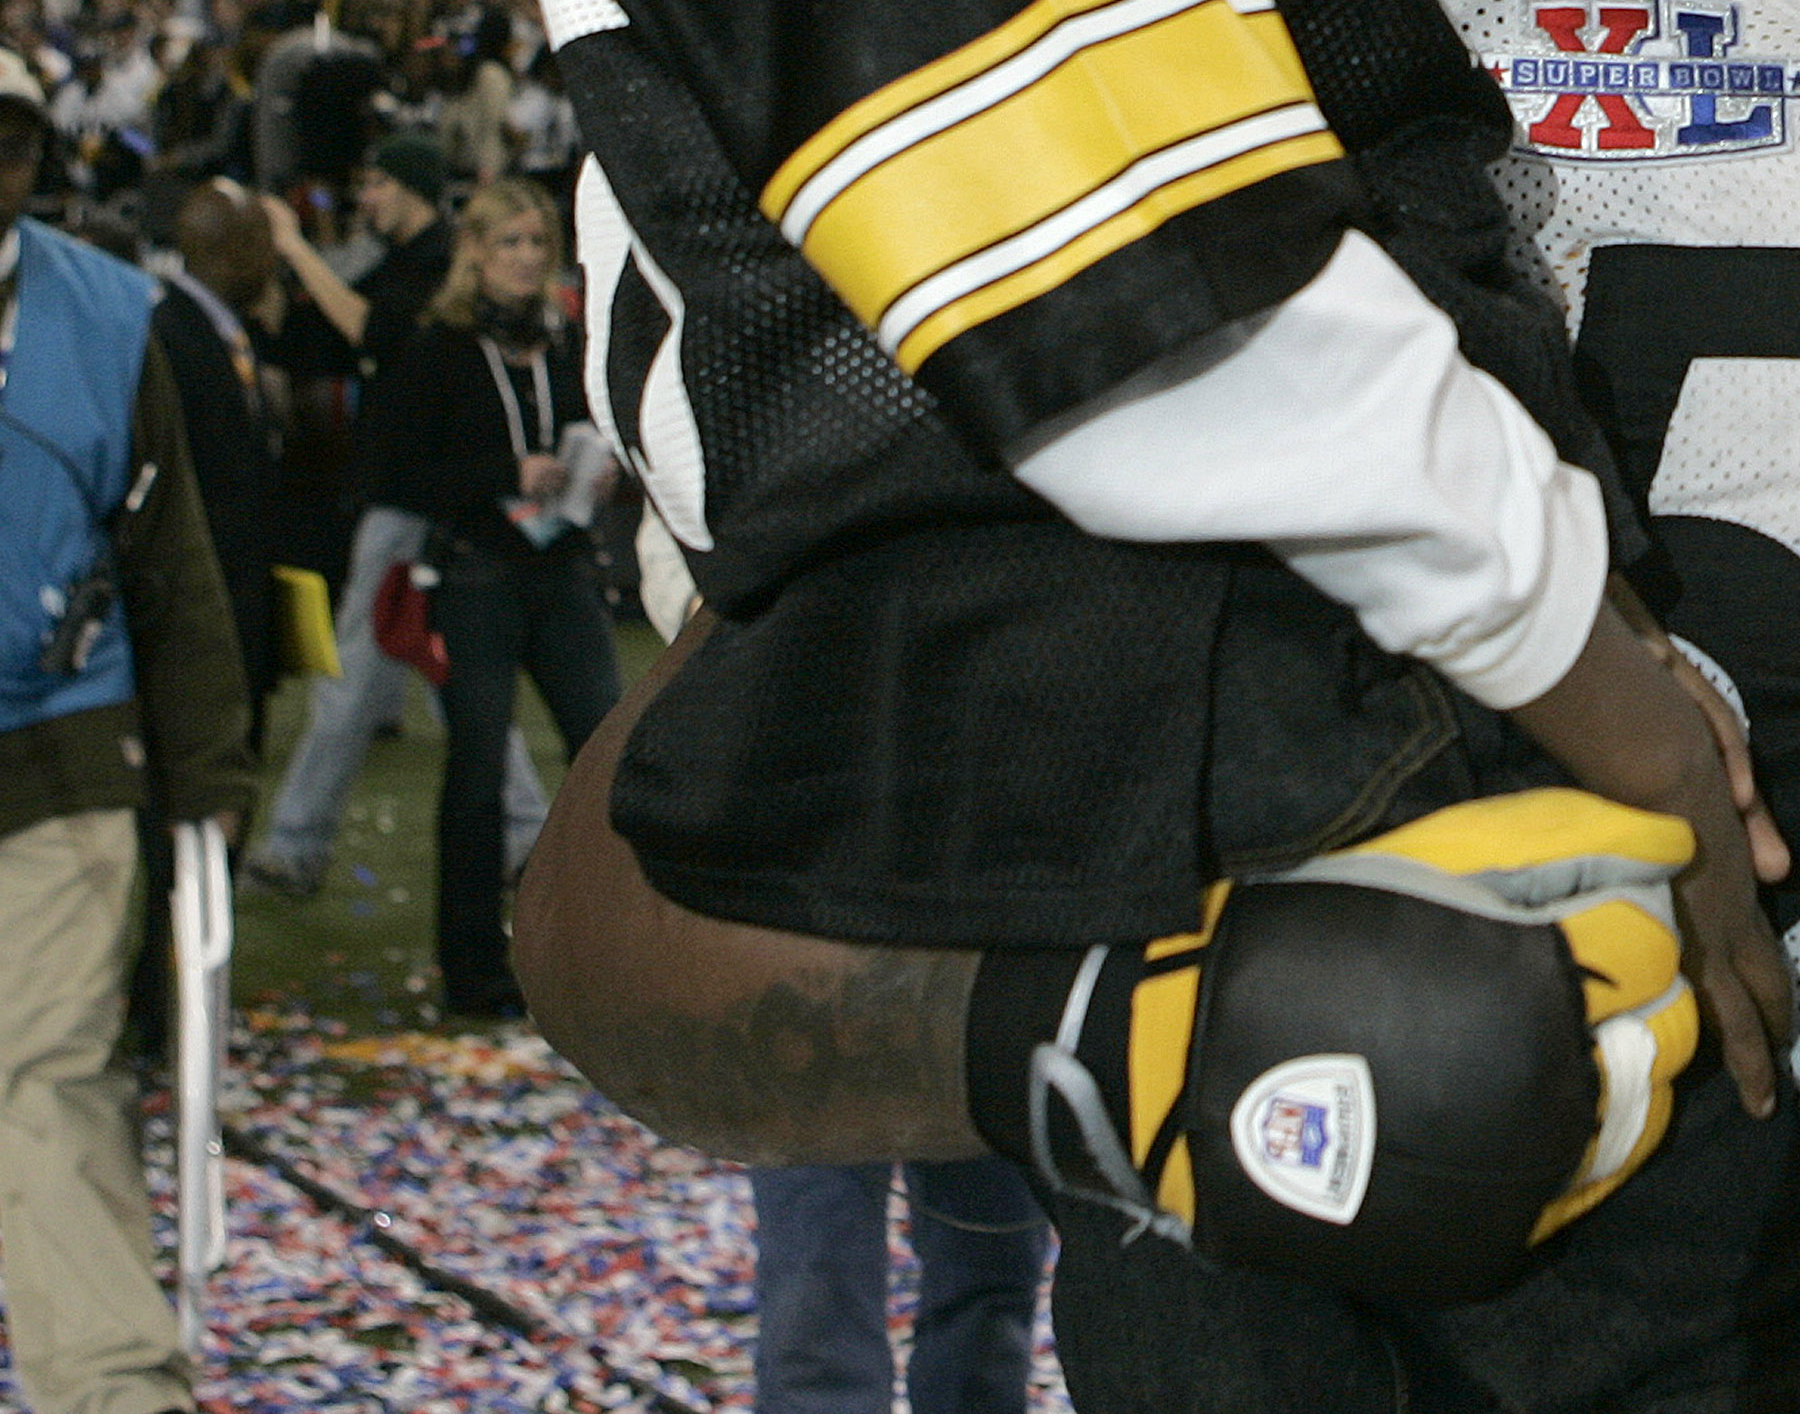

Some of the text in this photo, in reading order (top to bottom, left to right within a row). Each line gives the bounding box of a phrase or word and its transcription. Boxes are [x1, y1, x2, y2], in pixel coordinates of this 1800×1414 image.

[1515, 62, 1783, 92] SUPER BOWL
[1529, 7, 1773, 149] XL
